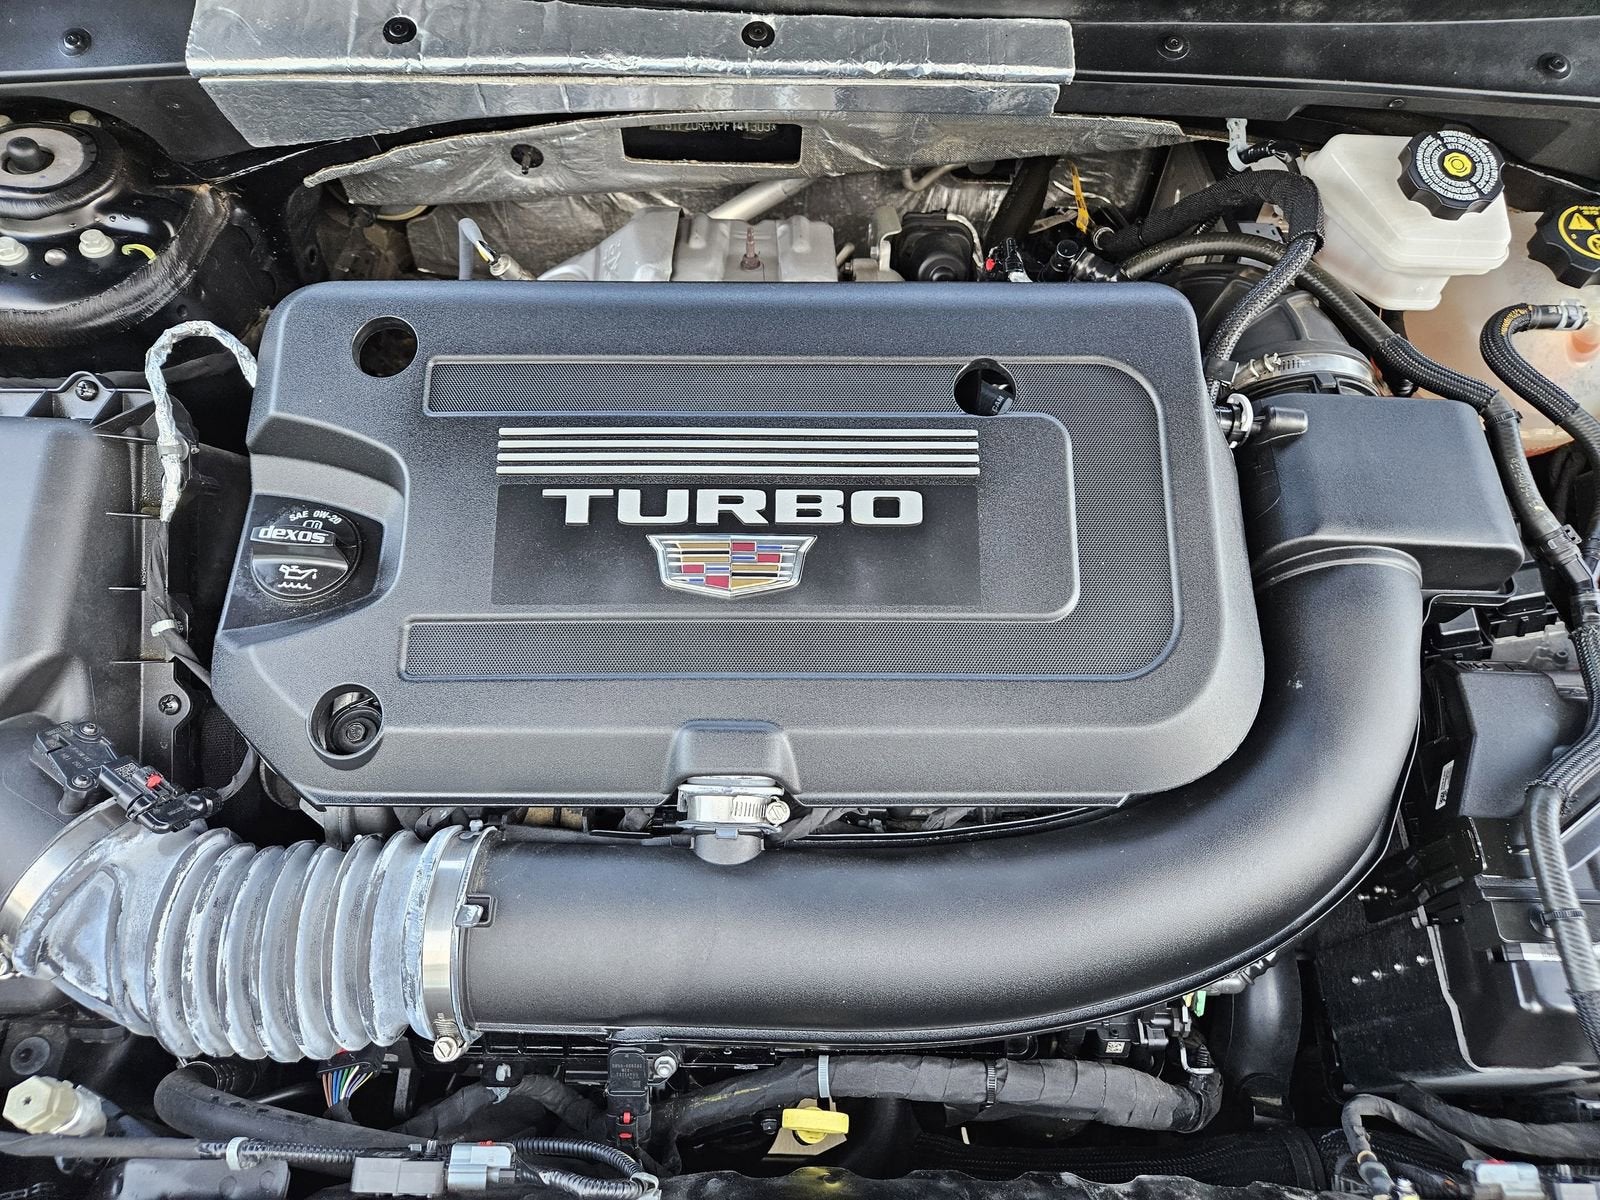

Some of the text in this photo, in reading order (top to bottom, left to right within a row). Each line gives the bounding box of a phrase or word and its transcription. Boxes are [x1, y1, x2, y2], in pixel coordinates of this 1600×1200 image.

[542, 488, 923, 525] TURBO
[289, 510, 342, 524] SAE 0W-20
[259, 525, 329, 543] dexos
